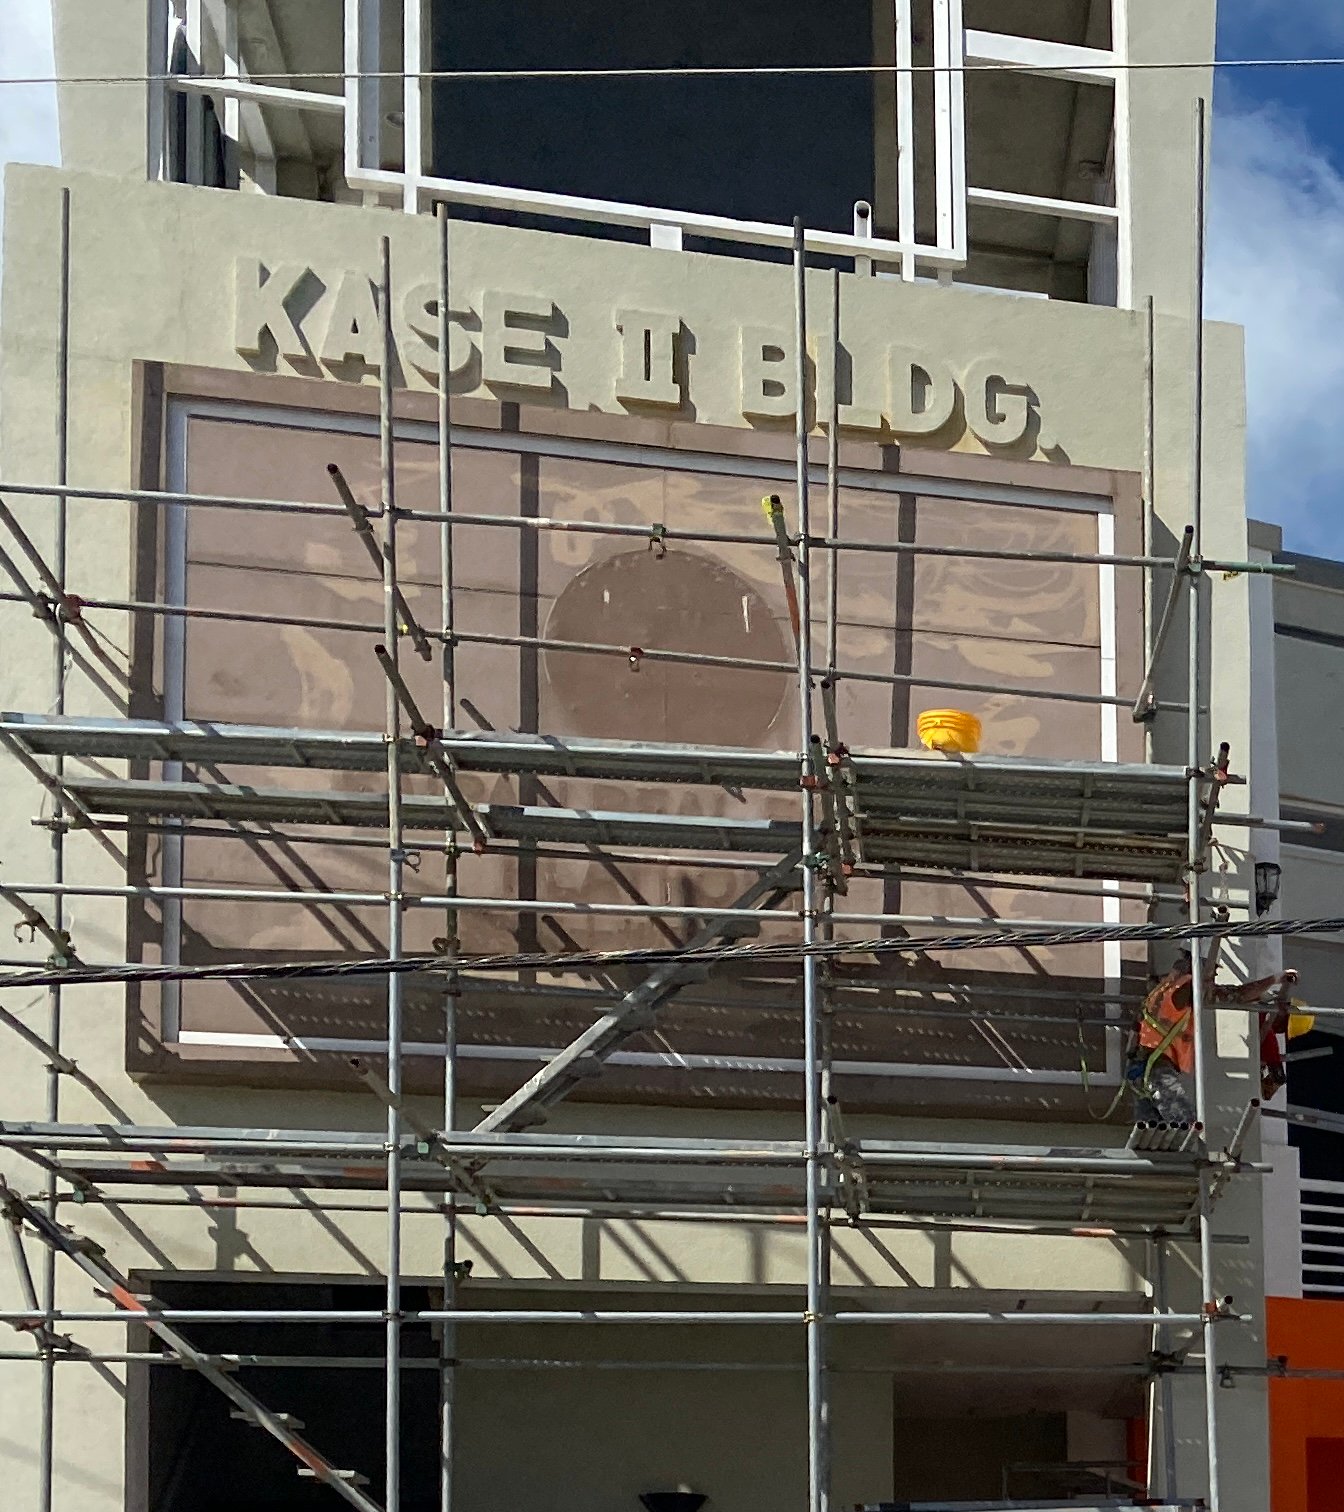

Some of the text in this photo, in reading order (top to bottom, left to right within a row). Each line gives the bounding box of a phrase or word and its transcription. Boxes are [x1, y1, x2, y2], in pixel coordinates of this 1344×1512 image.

[234, 257, 1067, 462] KASE II BLDG.
